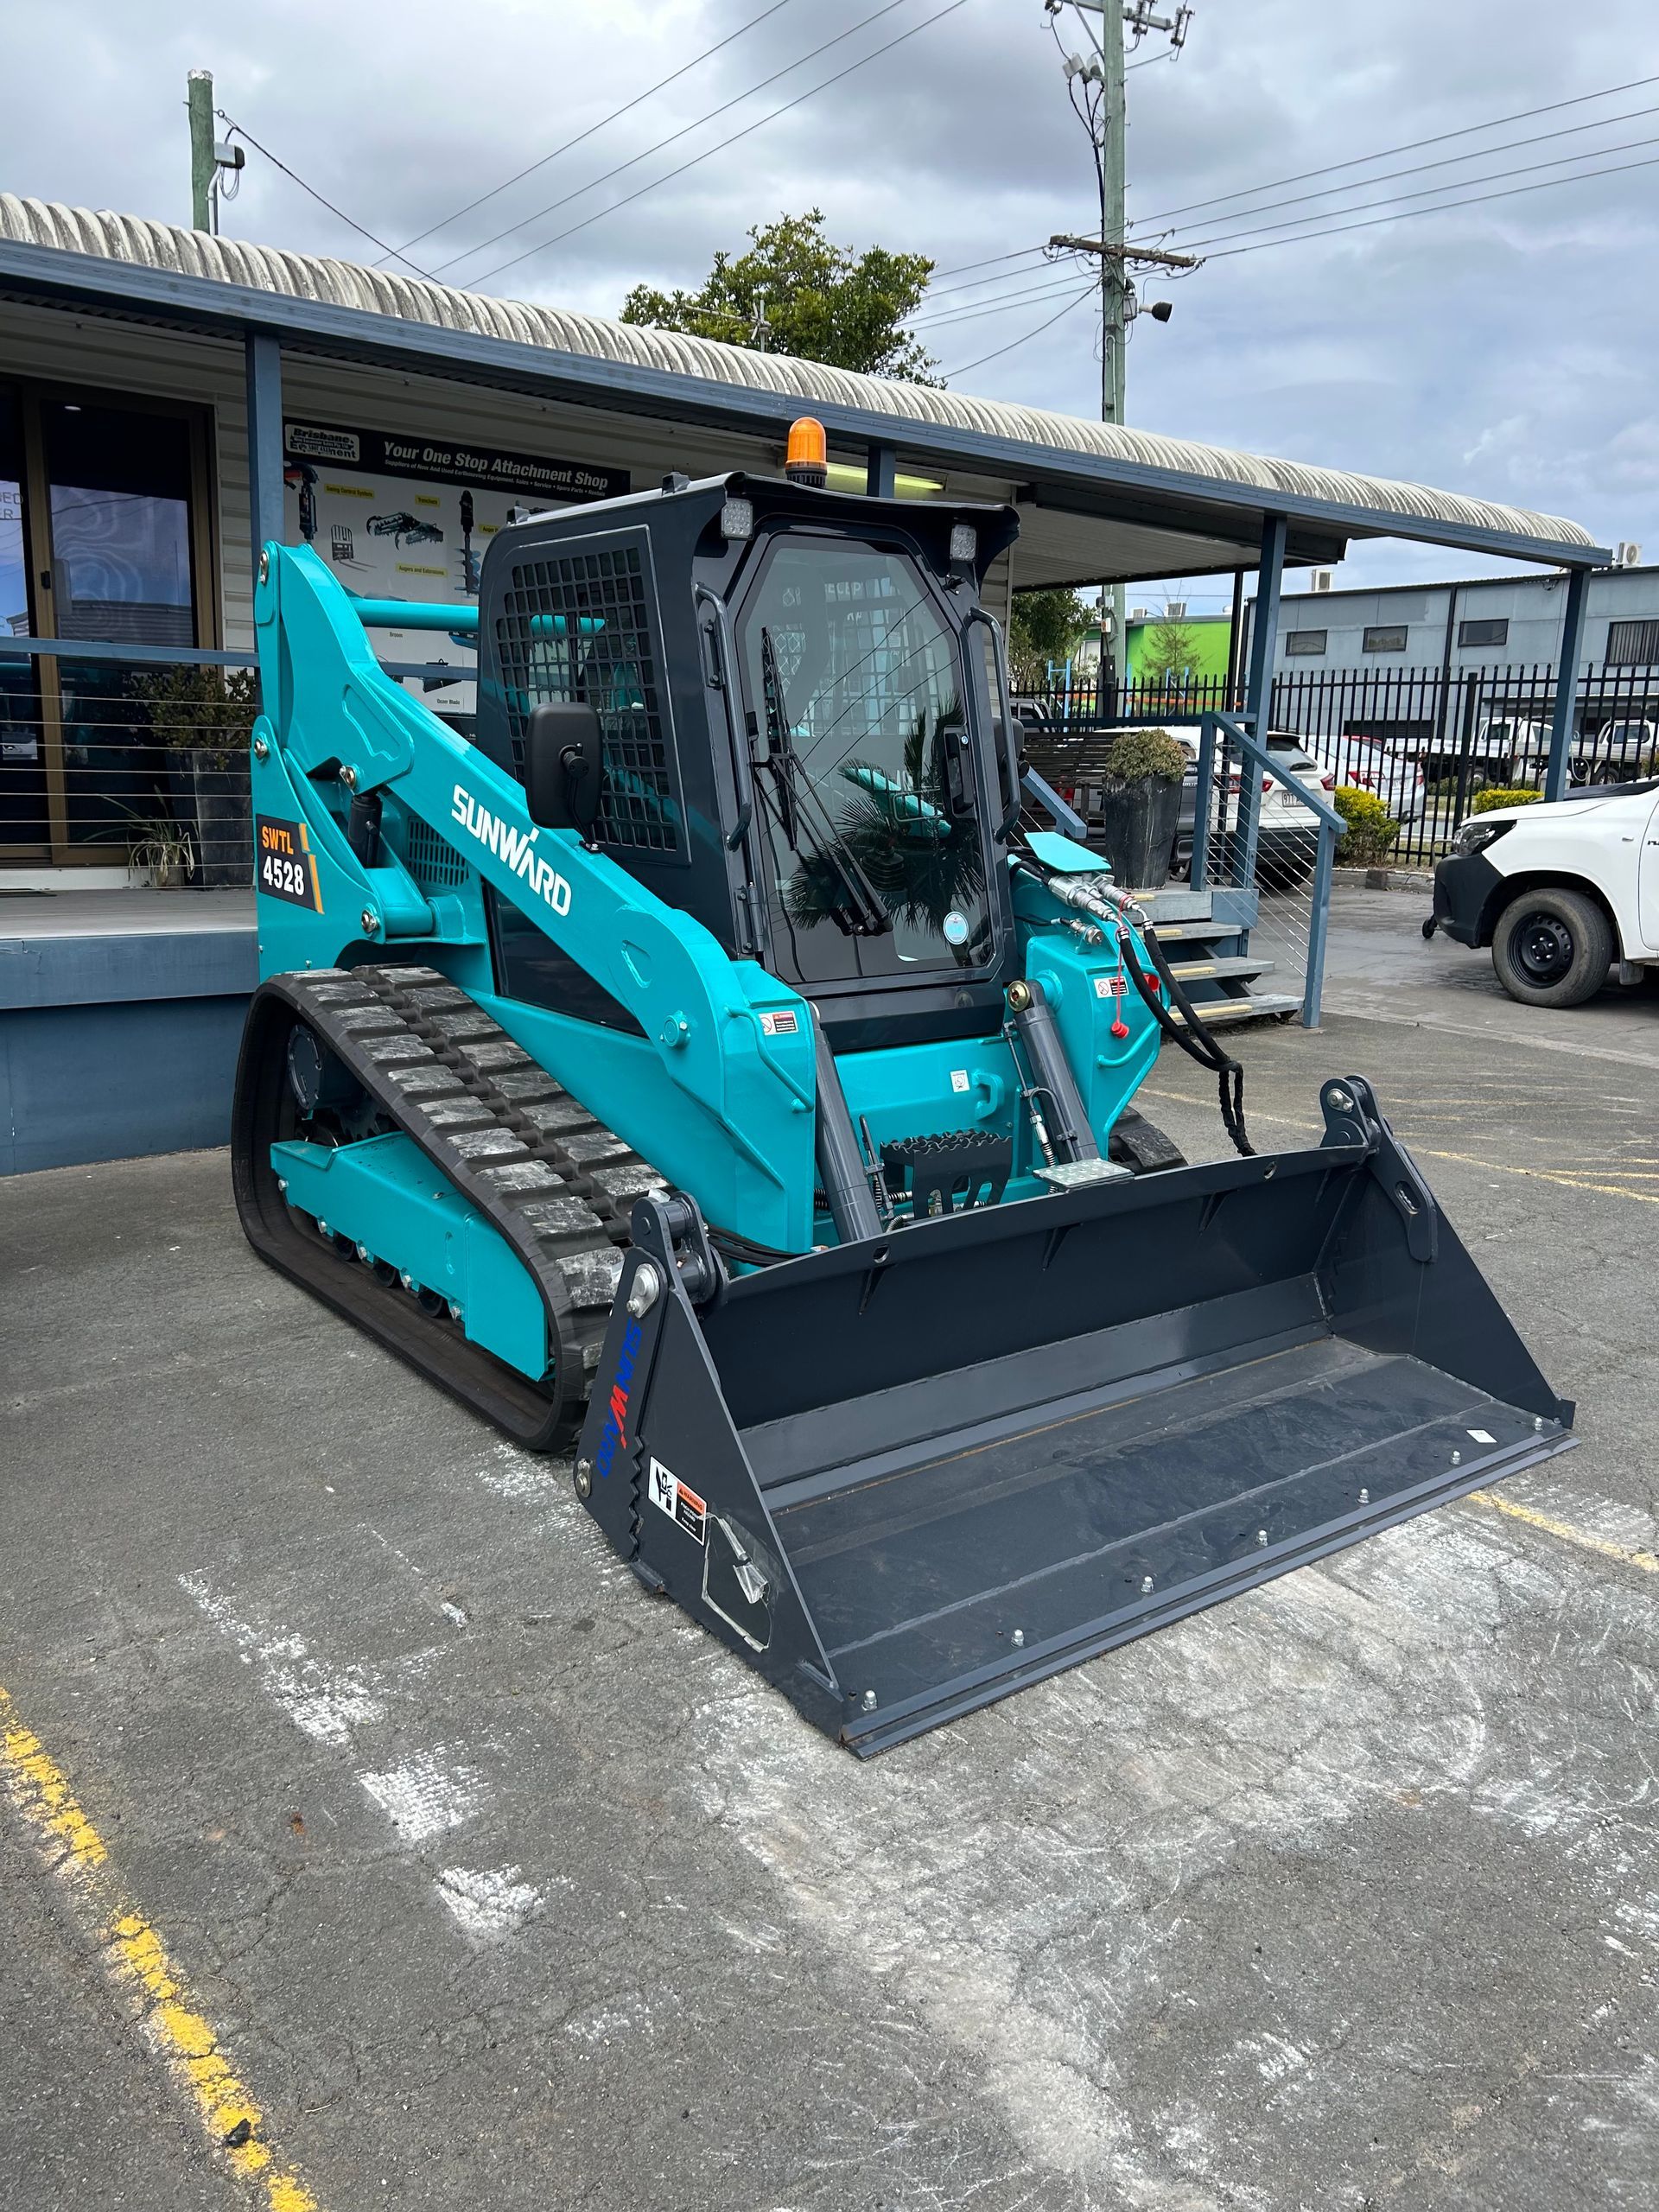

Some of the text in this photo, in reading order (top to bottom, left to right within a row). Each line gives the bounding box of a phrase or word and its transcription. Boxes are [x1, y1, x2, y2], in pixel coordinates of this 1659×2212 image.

[294, 428, 350, 443] Brisbane
[384, 441, 608, 490] Your One Stop Attachment Shop
[385, 459, 410, 469] Suppliers
[534, 480, 552, 489] Service
[262, 825, 294, 855] SWTL
[451, 784, 572, 917] SUNWARD
[263, 855, 304, 895] 4528
[596, 1317, 642, 1478] SUNWARD
[683, 1491, 703, 1511] WARNING
